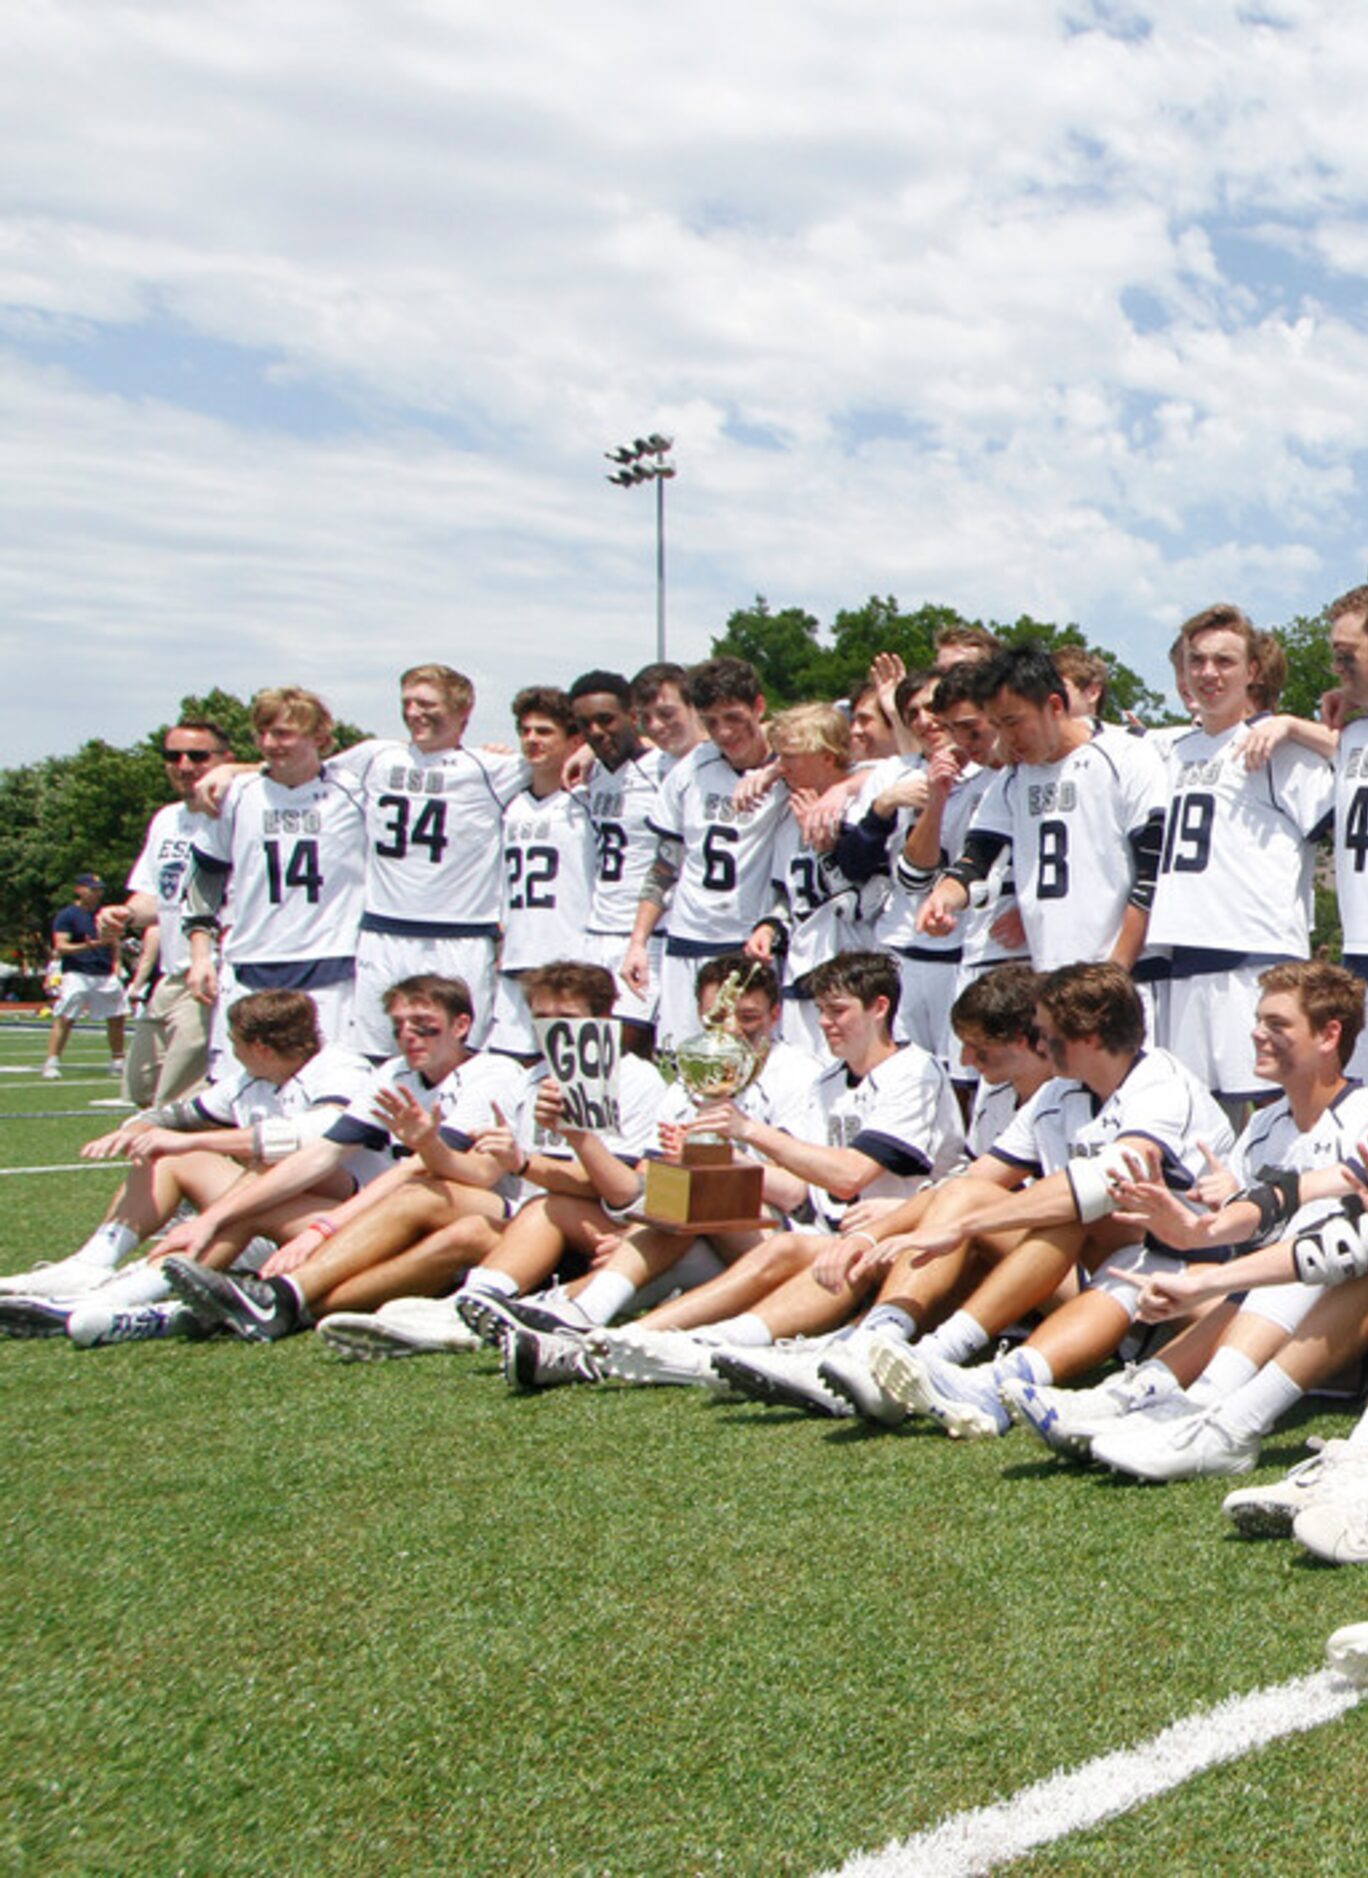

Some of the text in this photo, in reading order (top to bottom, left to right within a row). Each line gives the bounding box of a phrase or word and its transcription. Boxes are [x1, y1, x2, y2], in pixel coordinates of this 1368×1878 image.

[263, 809, 321, 834] ESD
[375, 796, 447, 863] 34
[1029, 781, 1076, 816] ESD
[158, 839, 190, 858] ES
[703, 825, 738, 892] 6
[1037, 820, 1069, 899] 8
[1162, 793, 1216, 873] 19
[264, 840, 323, 903] 14
[505, 846, 559, 909] 22
